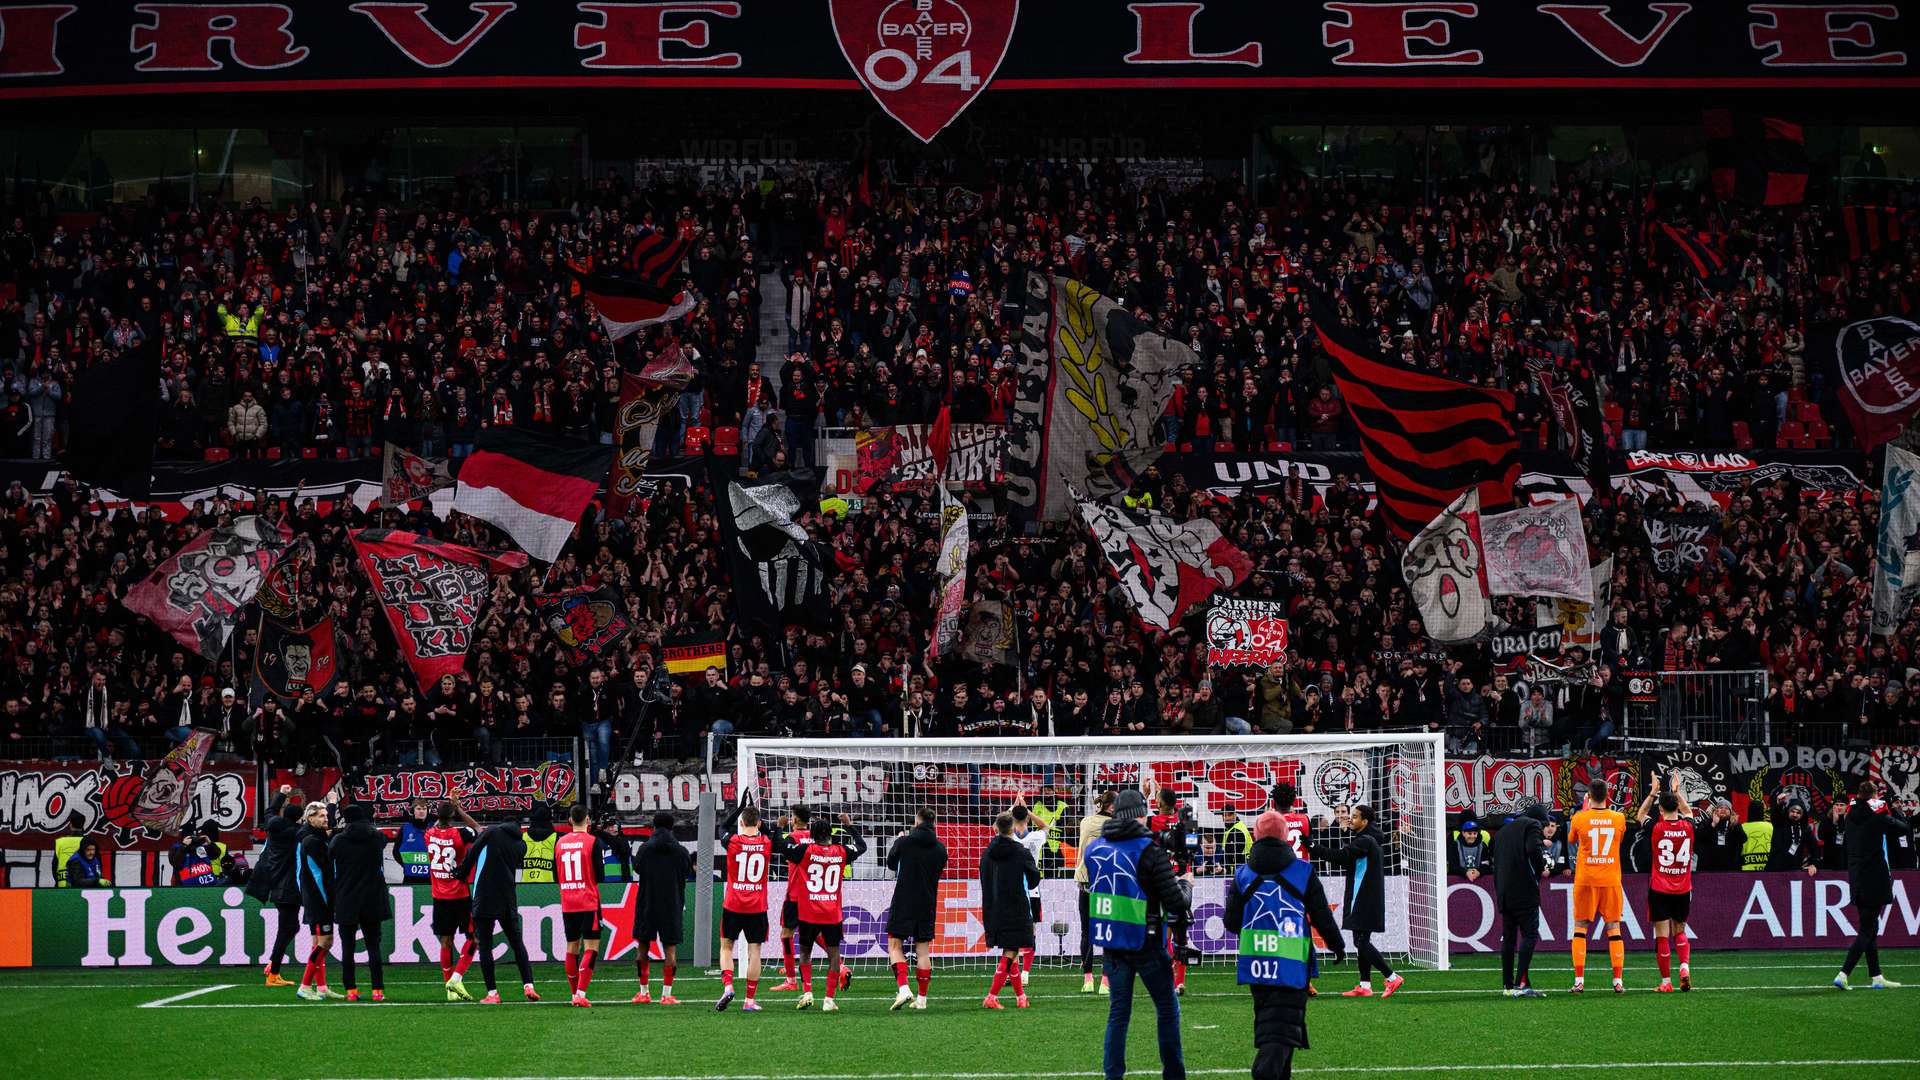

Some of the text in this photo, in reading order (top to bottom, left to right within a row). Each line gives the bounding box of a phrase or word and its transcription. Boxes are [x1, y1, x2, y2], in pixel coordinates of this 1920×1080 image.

[882, 23, 966, 36] BAYER
[864, 49, 981, 91] 04
[1213, 459, 1332, 482] UND
[1729, 746, 1871, 777] MAD BOYZ
[1587, 827, 1617, 857] 17
[1663, 830, 1688, 838] XHAKA
[414, 853, 428, 863] HB
[428, 843, 457, 872] 23
[1657, 838, 1692, 867] 34
[1744, 854, 1770, 864] STEWA
[411, 865, 429, 875] 023
[523, 858, 553, 869] TEWARD
[561, 850, 583, 882] 11
[736, 851, 766, 883] 10
[1659, 866, 1680, 875] BAYER
[733, 883, 755, 891] BAYER
[806, 863, 841, 894] 30
[809, 893, 830, 901] BAYER
[1253, 933, 1279, 953] HB
